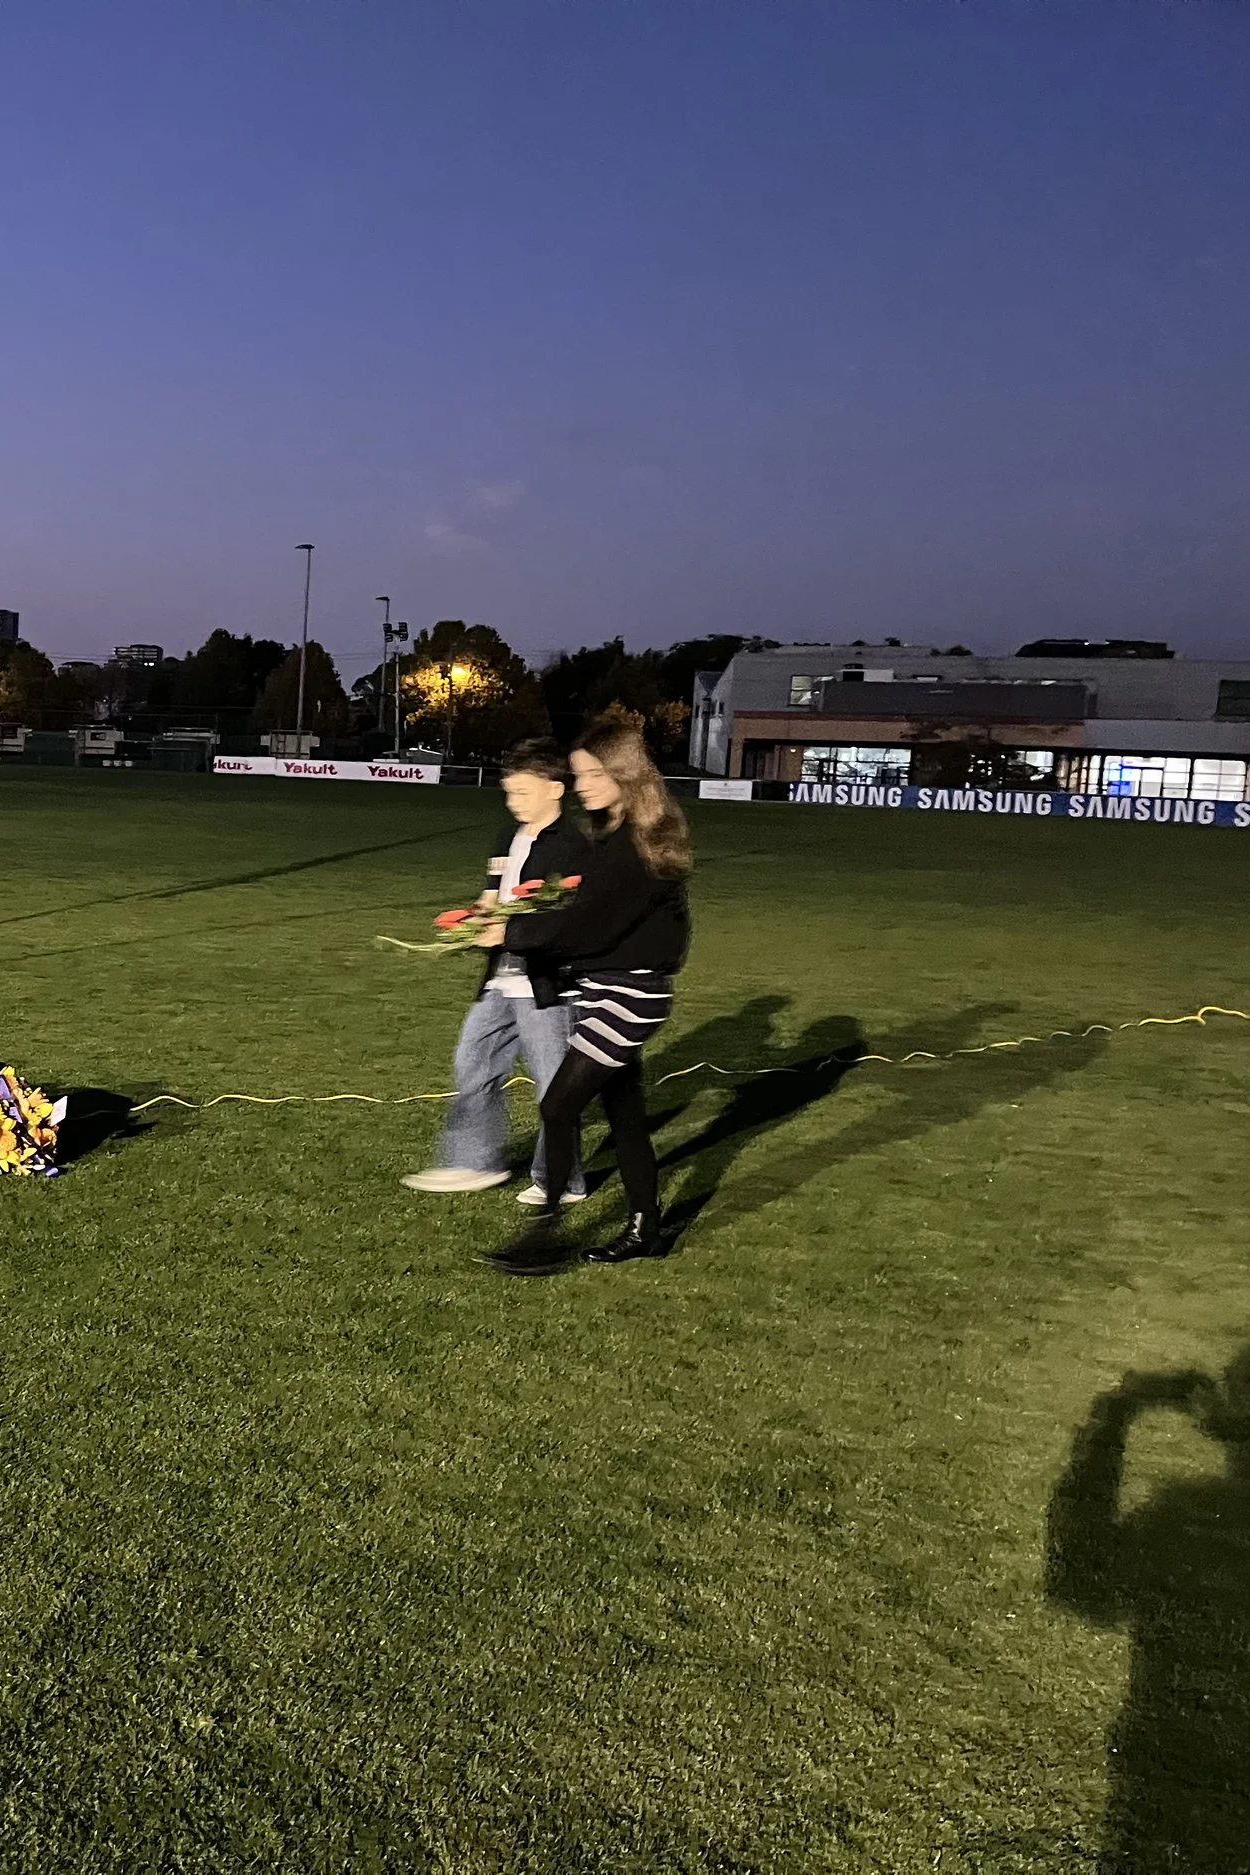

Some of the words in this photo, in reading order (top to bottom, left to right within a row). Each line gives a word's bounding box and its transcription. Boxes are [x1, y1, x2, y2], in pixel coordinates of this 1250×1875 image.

[284, 761, 338, 776] Yakult
[367, 765, 424, 780] Yakult
[917, 787, 1052, 816] SAMSUNG
[1068, 794, 1215, 825] SAMSUNG
